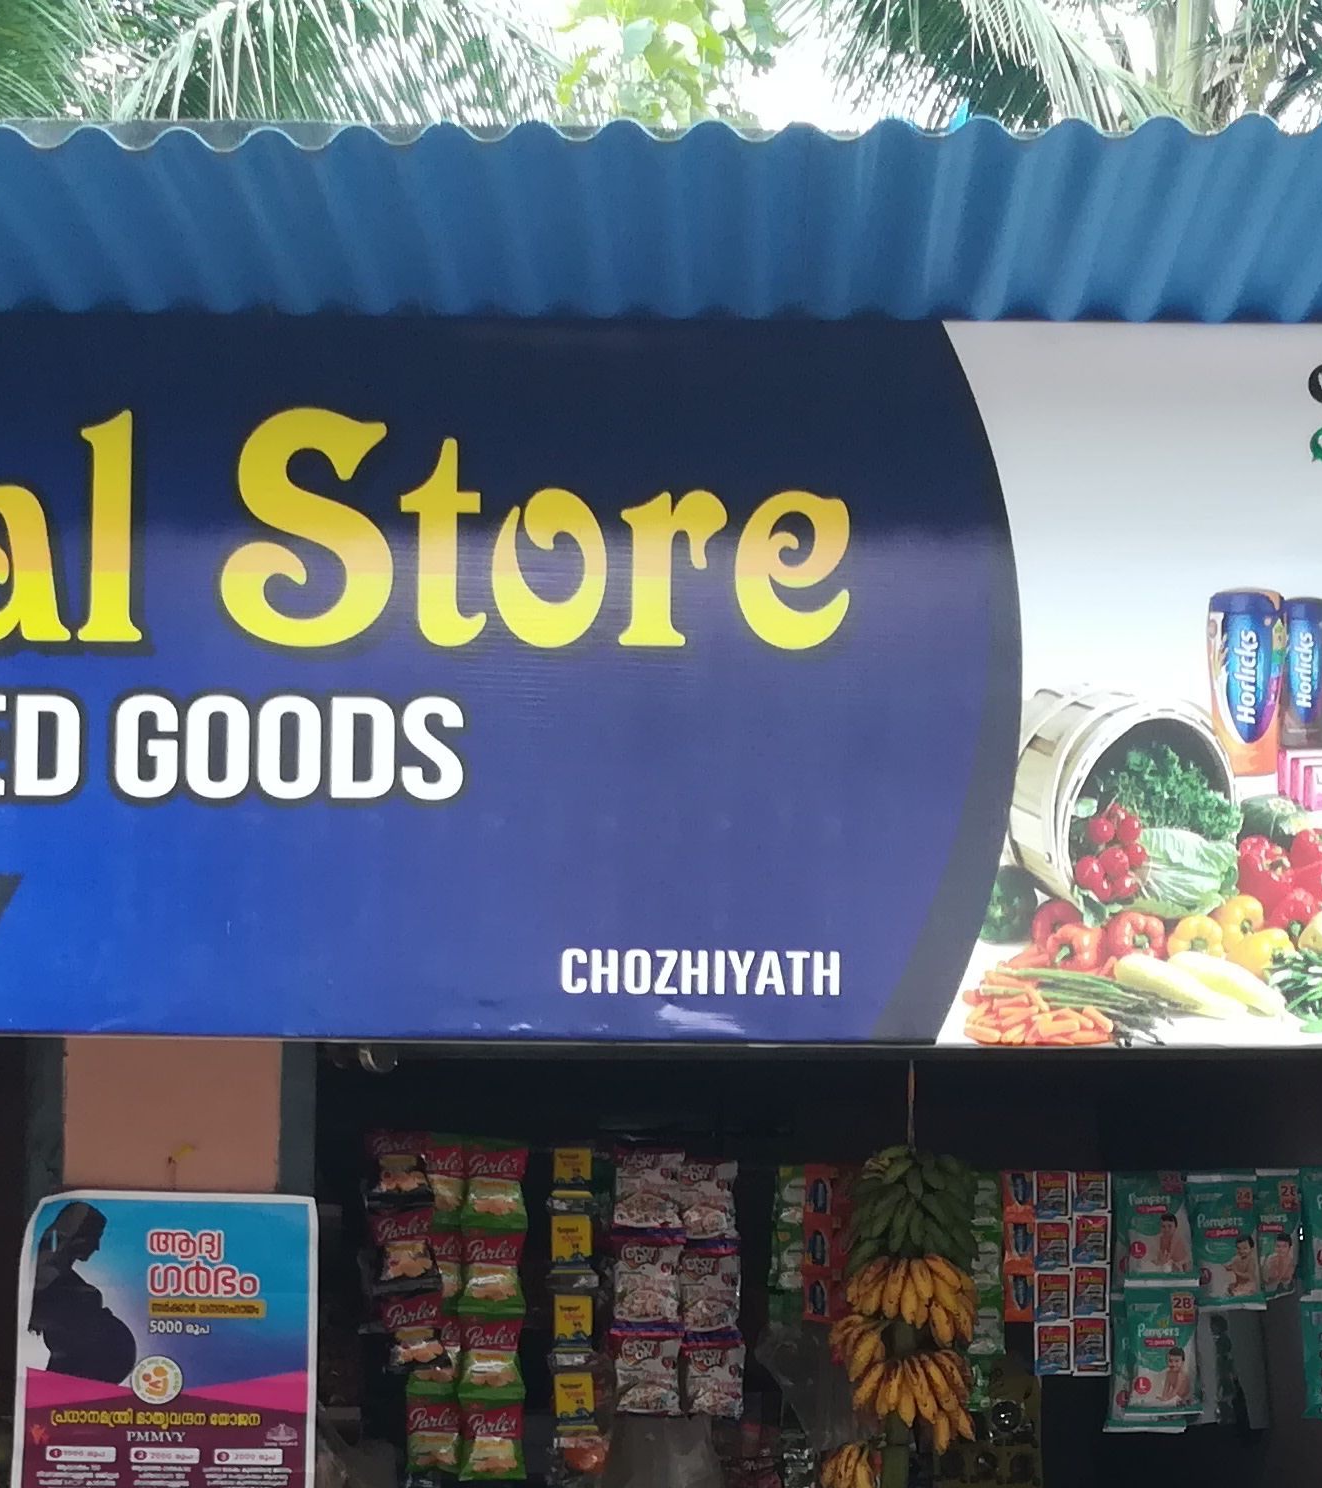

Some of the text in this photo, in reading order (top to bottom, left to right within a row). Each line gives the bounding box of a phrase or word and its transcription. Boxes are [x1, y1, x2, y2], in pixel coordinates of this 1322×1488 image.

[219, 406, 852, 651] Store
[1236, 629, 1259, 725] Horlicks
[1295, 631, 1315, 708] Horlicks
[113, 692, 467, 802] GOODS
[560, 946, 842, 998] CHOZHIYATH
[468, 1153, 518, 1175] Parle's
[1196, 1214, 1244, 1228] Pampers
[466, 1239, 518, 1261] Parle's
[386, 1302, 438, 1328] Parle's
[149, 1320, 183, 1334] 5000
[465, 1325, 517, 1347] Parle's
[1137, 1323, 1180, 1338] Pampers
[466, 1412, 517, 1434] Parle's
[126, 1430, 187, 1442] PMMVY
